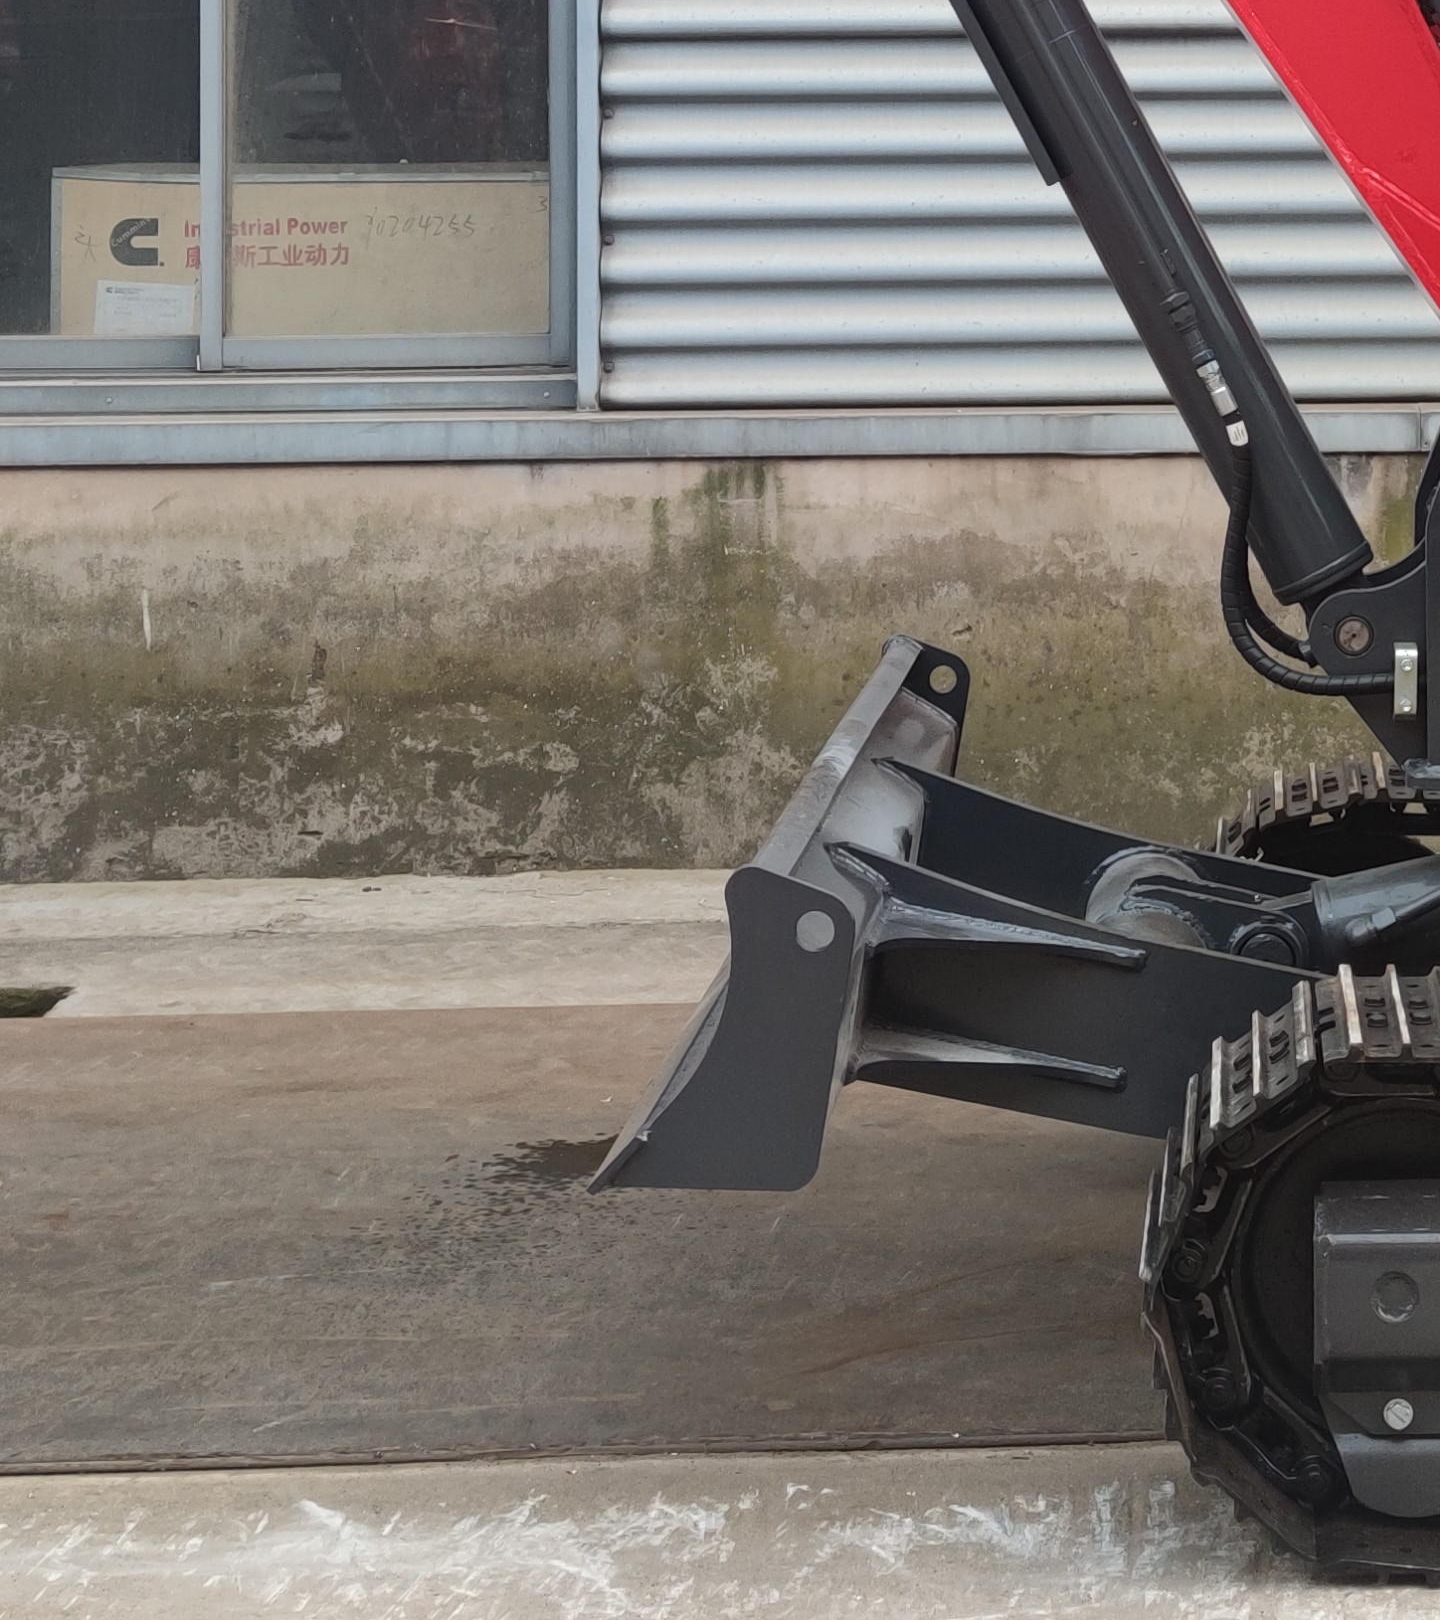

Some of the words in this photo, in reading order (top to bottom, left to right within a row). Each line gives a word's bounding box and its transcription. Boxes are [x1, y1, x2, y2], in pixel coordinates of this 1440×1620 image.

[184, 218, 281, 238] Instrial
[287, 217, 348, 236] Power
[185, 241, 350, 270] 康斯工业动力
